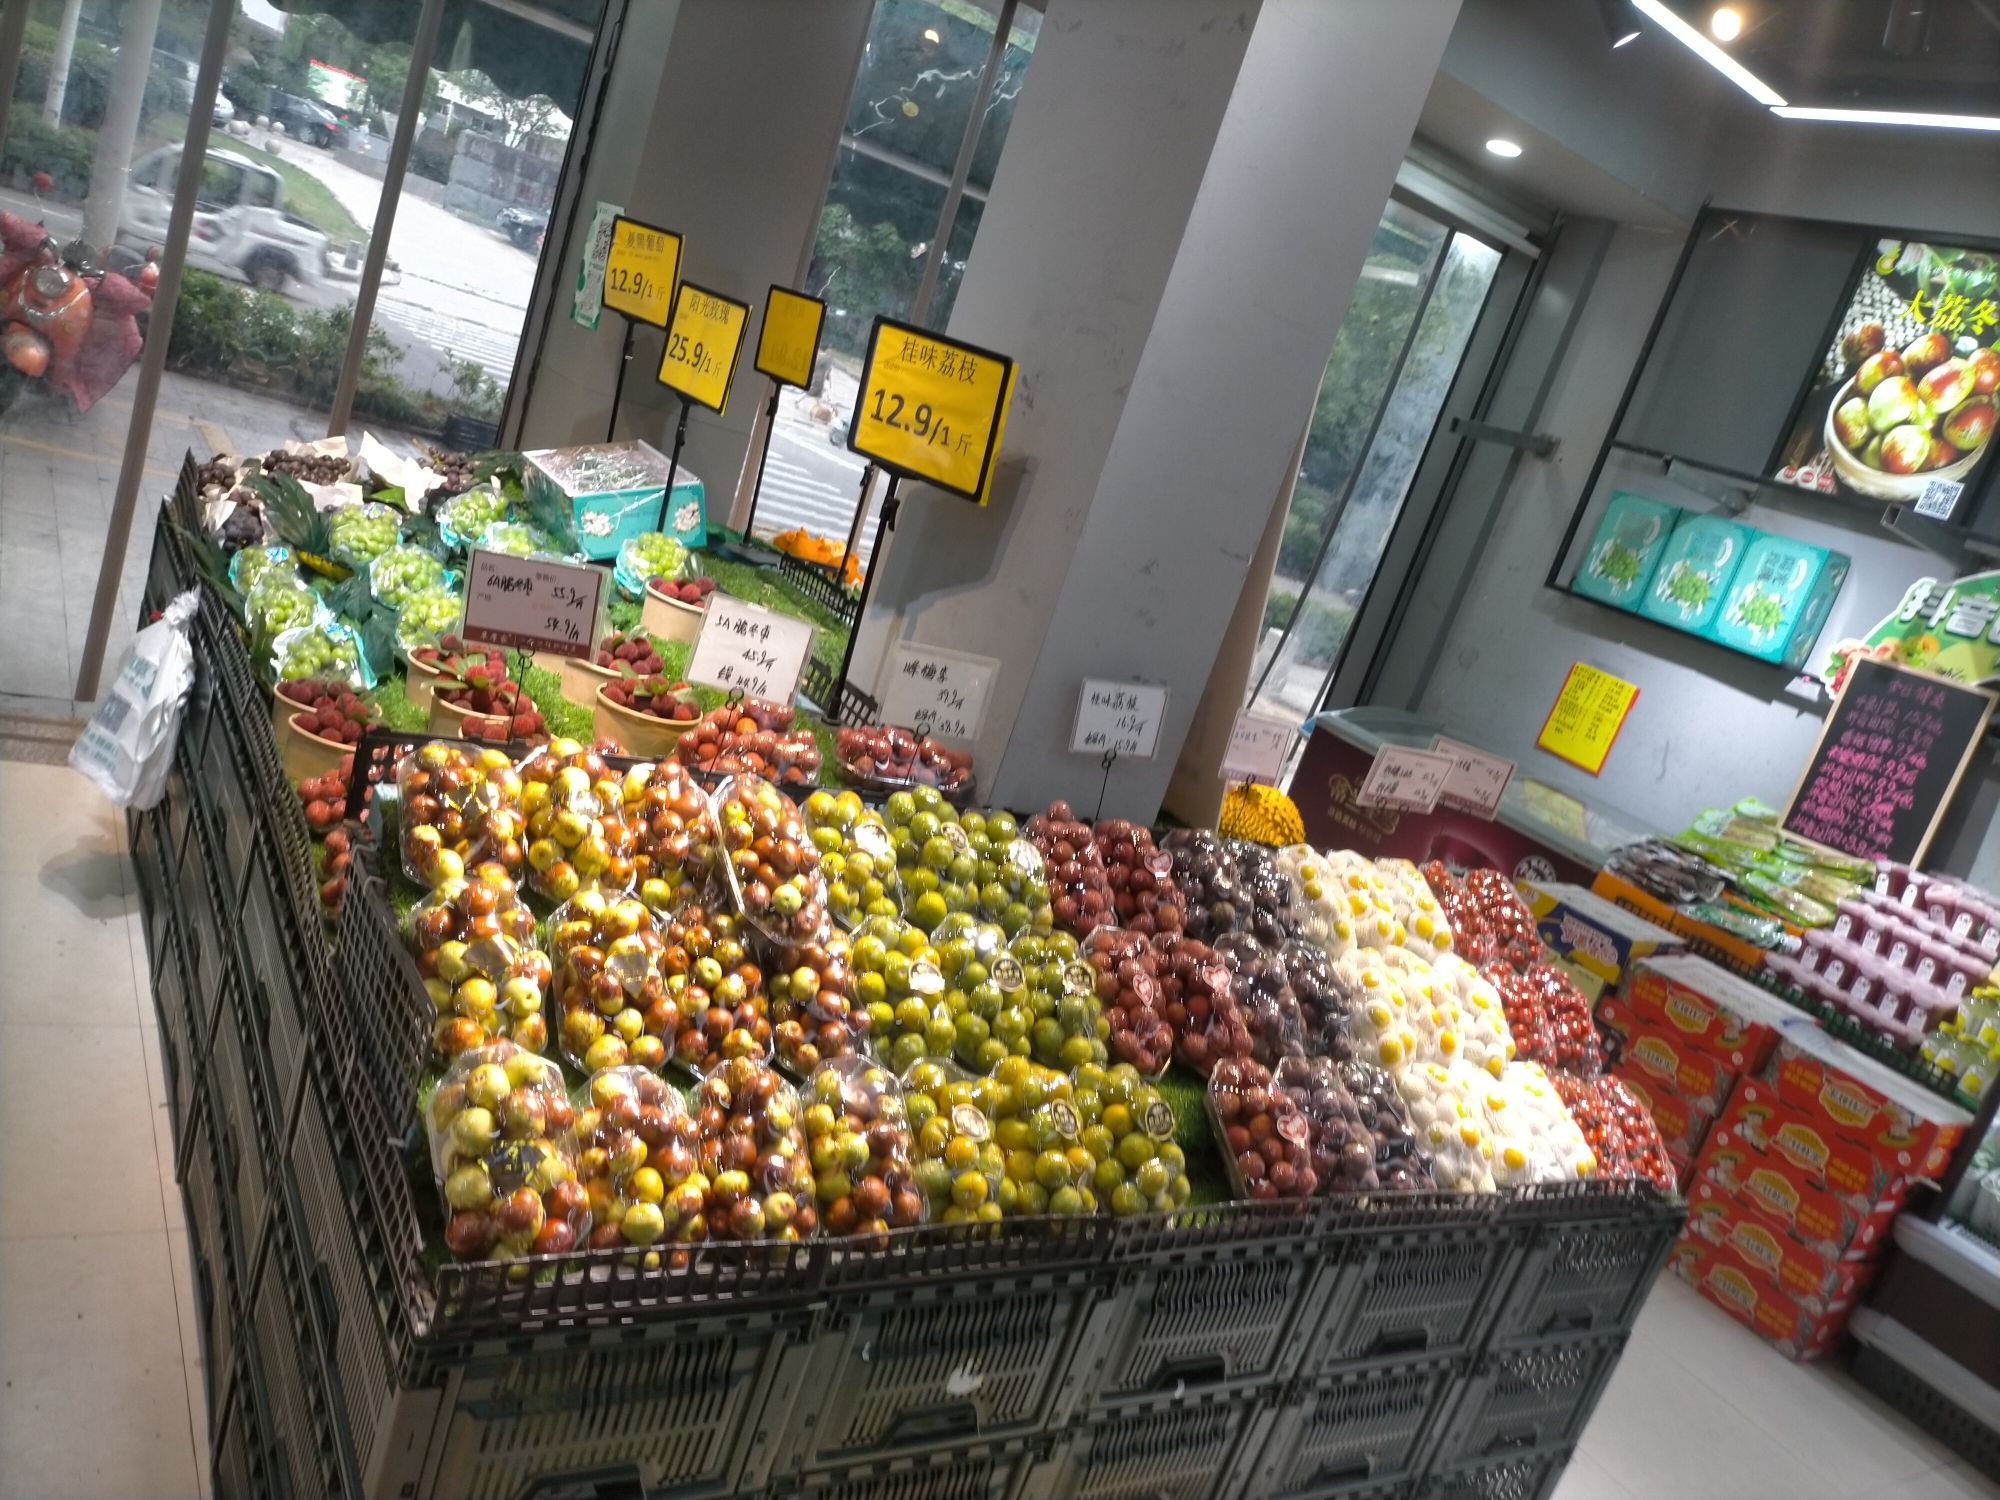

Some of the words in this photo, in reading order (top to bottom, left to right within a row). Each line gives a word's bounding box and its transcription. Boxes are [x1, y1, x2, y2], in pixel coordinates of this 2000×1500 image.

[688, 293, 731, 325] 阳光玫瑰
[901, 336, 978, 385] 桂味荔枝
